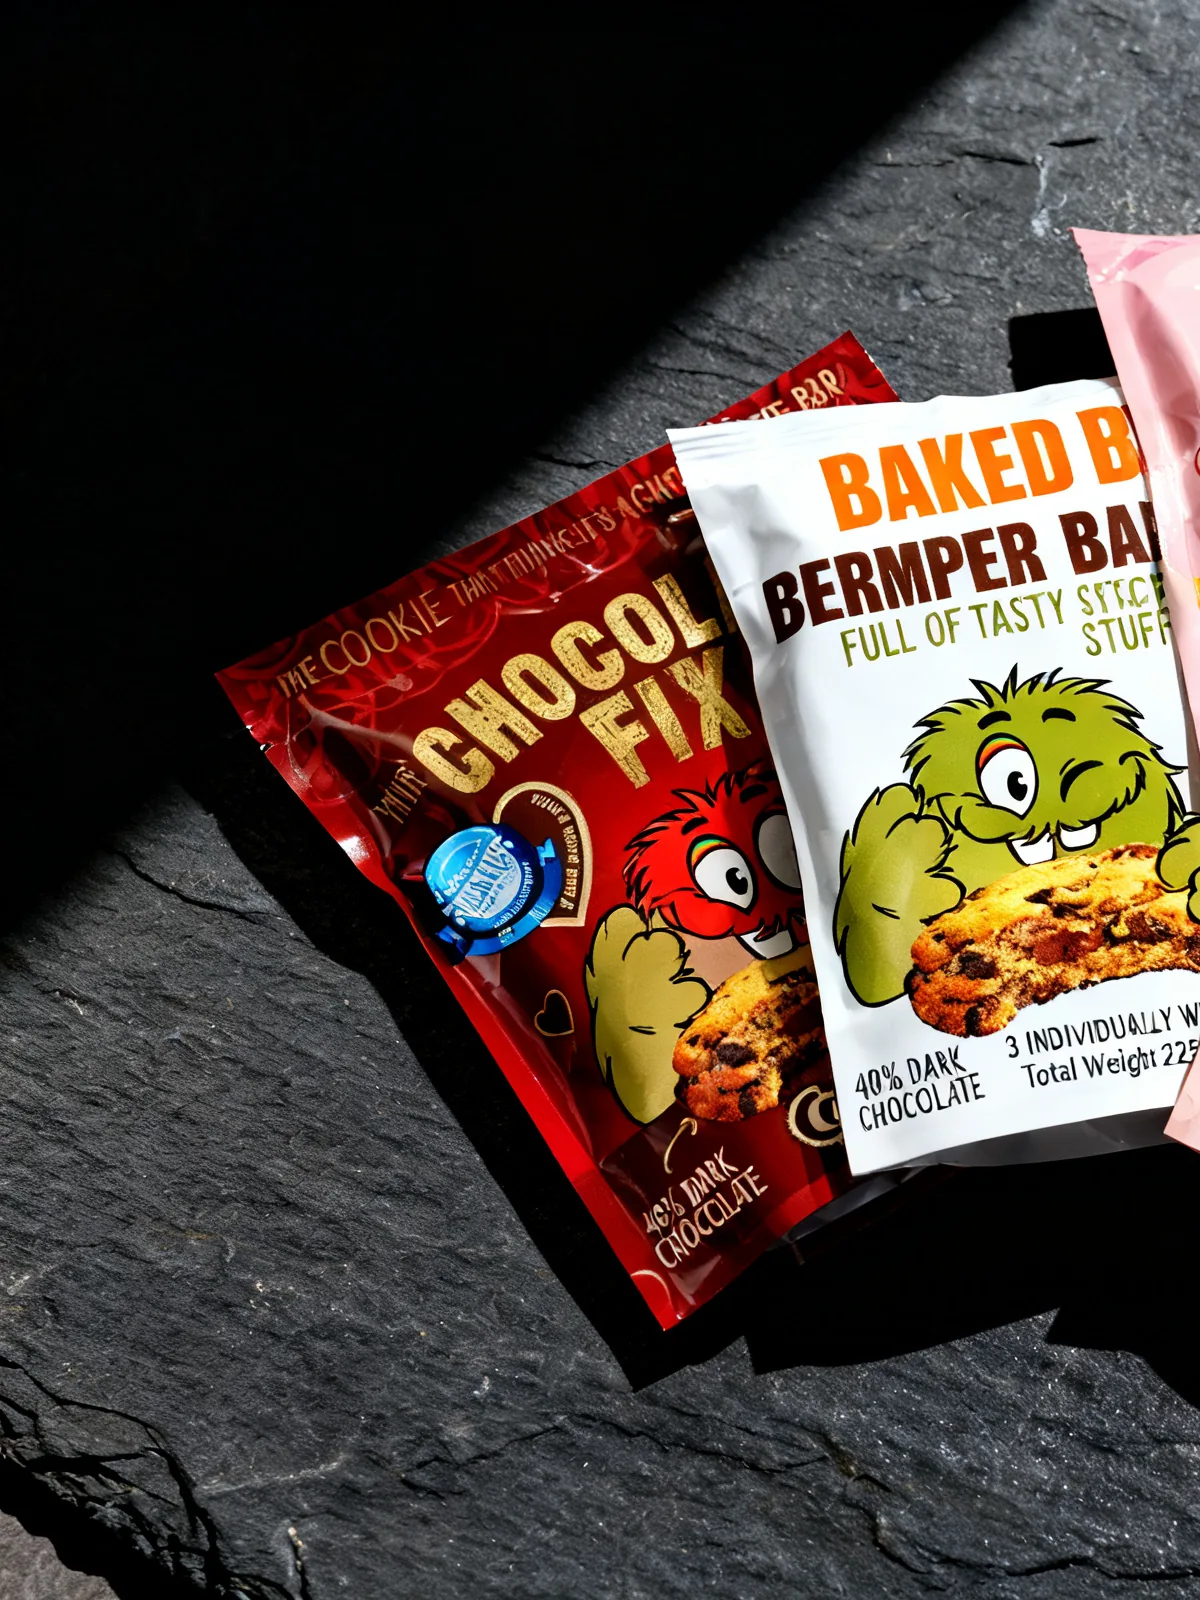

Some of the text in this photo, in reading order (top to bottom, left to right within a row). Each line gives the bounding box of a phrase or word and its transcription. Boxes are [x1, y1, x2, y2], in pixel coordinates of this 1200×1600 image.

[818, 418, 1075, 532] BAKED
[1075, 404, 1149, 485] B
[762, 521, 1048, 645] BERMPER
[319, 588, 454, 676] COOKIE
[840, 619, 917, 668] FULL
[924, 605, 962, 648] OF
[968, 588, 1064, 640] TASTY
[412, 572, 732, 794] CHOCOL
[579, 646, 752, 789] FIX
[855, 1045, 967, 1100] 40% DARK
[1005, 1035, 1020, 1059] 3
[1020, 1056, 1078, 1089] Total
[1081, 1046, 1157, 1079] Weight
[859, 1072, 986, 1132] CHOCOLATE
[679, 1145, 740, 1207] DARK
